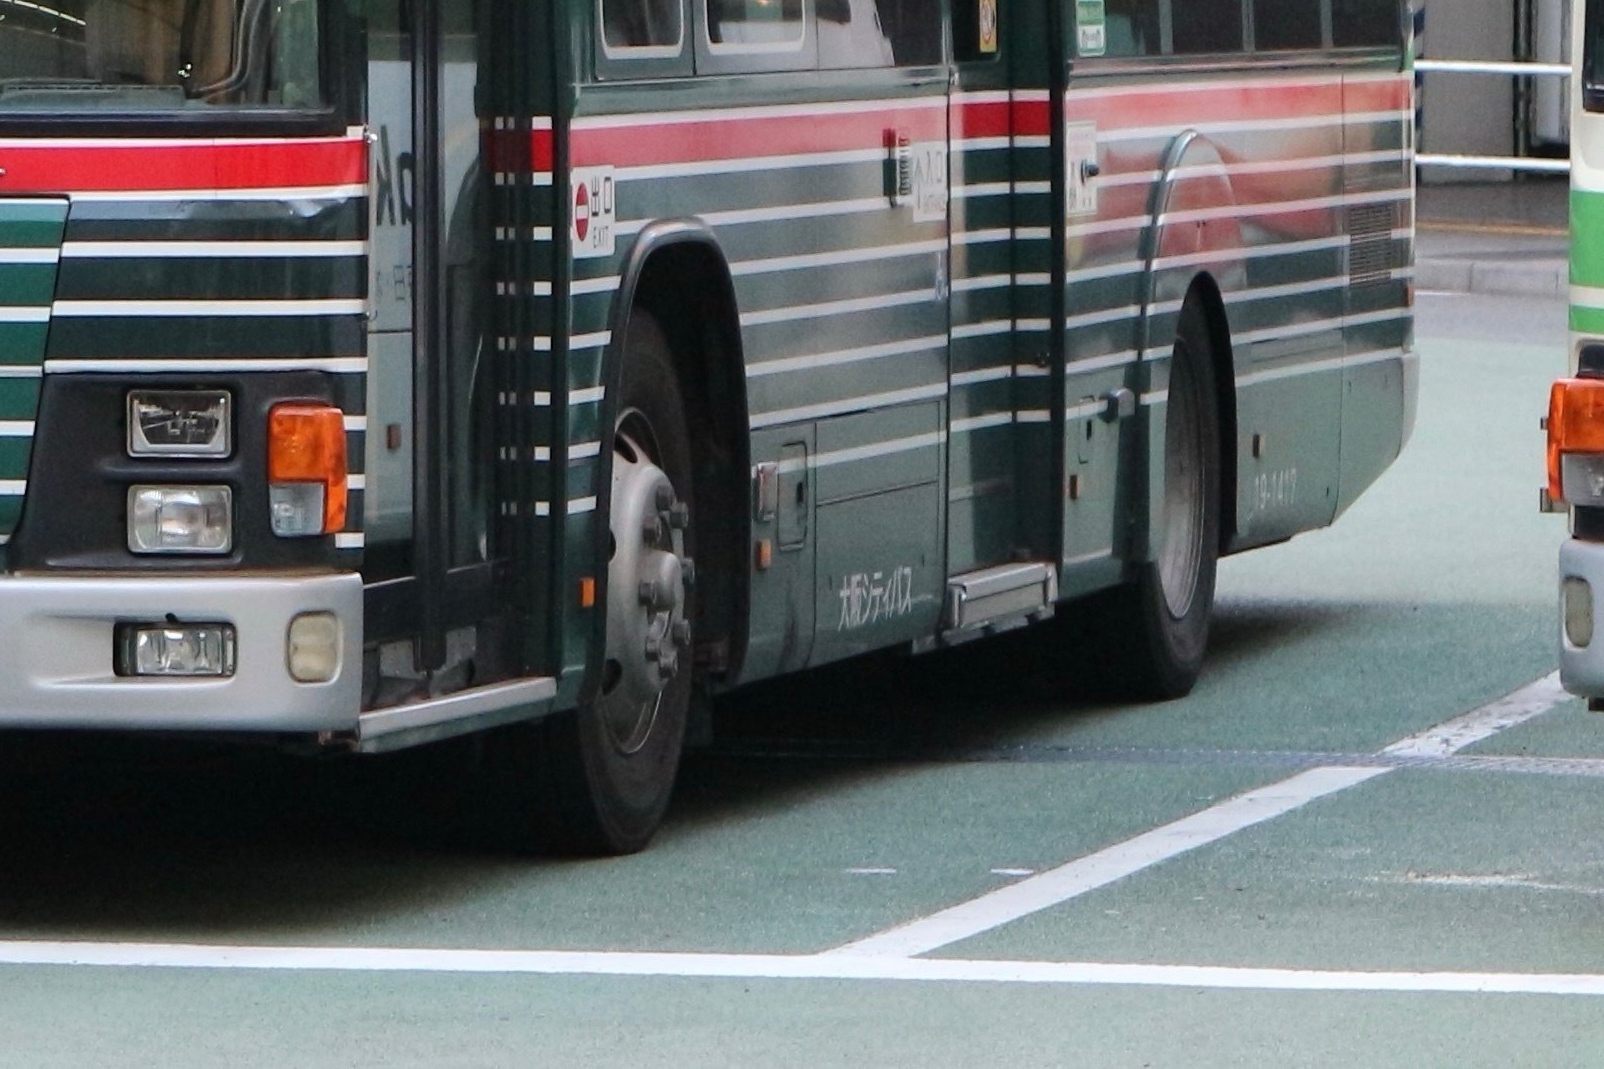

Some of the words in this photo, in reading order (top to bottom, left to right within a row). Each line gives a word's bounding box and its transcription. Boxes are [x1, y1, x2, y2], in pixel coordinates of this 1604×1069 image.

[591, 176, 612, 217] 出口
[837, 566, 912, 632] 大阪シティバス
